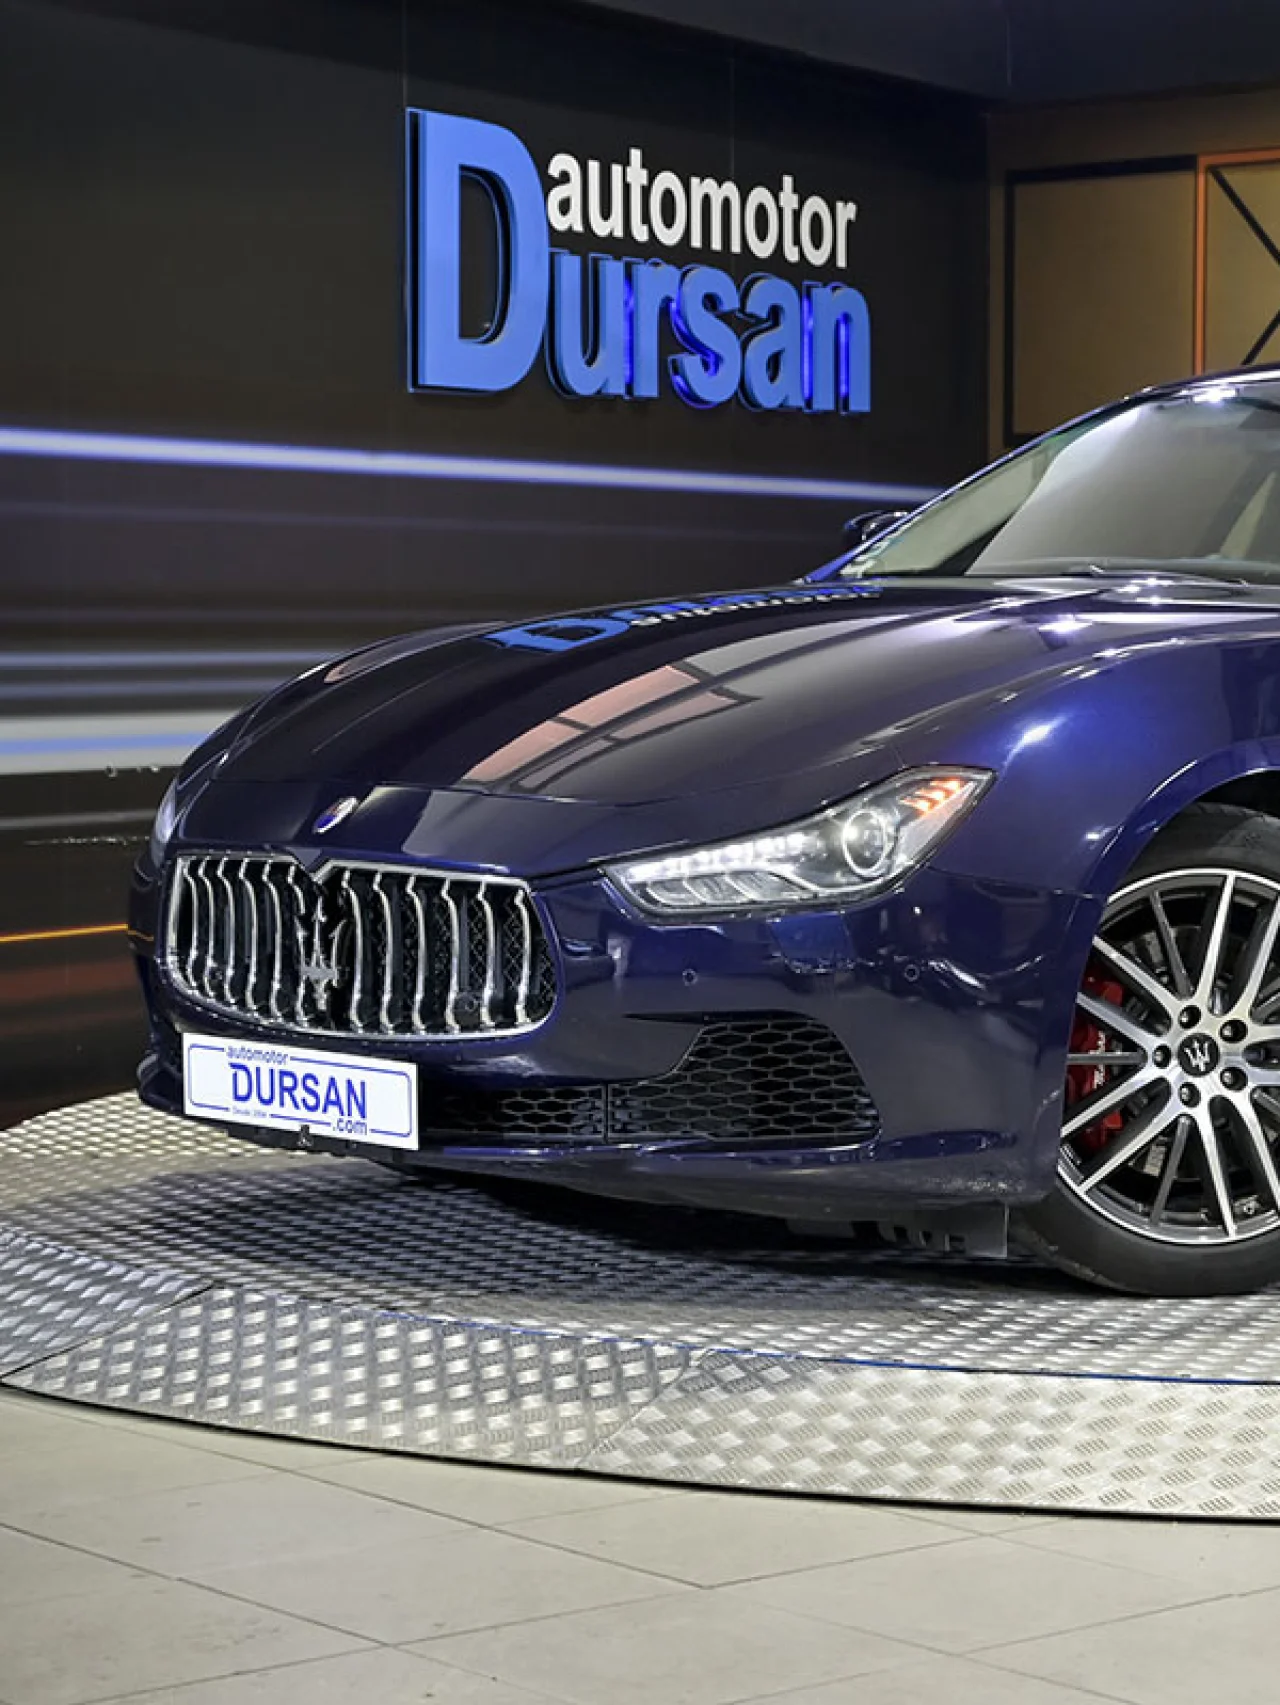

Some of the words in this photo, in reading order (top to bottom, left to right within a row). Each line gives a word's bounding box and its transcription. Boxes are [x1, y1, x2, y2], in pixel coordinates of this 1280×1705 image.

[547, 147, 856, 268] automotor
[405, 106, 873, 413] Dursan
[226, 1046, 288, 1065] automotor
[229, 1062, 367, 1118] DURSAN
[333, 1117, 367, 1135] .com
